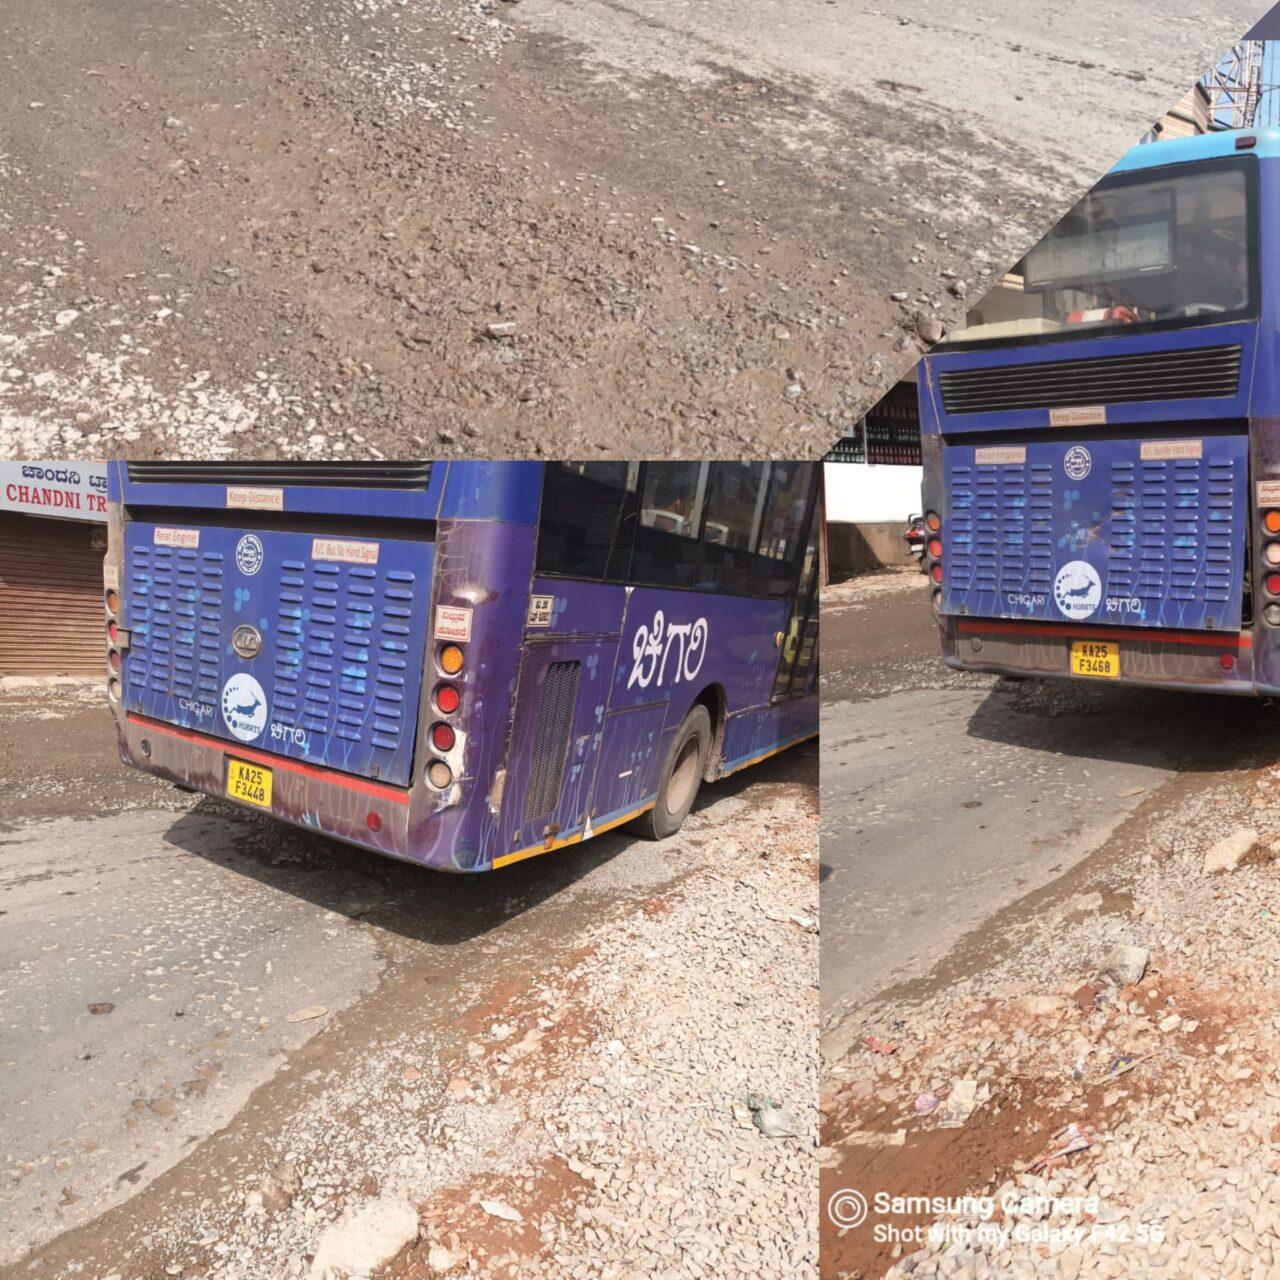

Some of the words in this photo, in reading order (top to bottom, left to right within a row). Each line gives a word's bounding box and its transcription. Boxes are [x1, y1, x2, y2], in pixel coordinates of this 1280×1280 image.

[22, 464, 81, 485] ಚಾಂದನಿ
[6, 483, 81, 510] CHANDNI
[87, 493, 107, 513] TR
[229, 490, 247, 503] Keep
[248, 490, 281, 505] Distance
[156, 530, 171, 541] Rear
[172, 531, 197, 544] Engine
[1007, 593, 1046, 606] CHIGARI
[1082, 644, 1108, 659] KA25
[1079, 660, 1111, 673] F3468
[178, 697, 214, 718] CHIGARI
[239, 765, 263, 785] KA25
[235, 780, 265, 802] F3448
